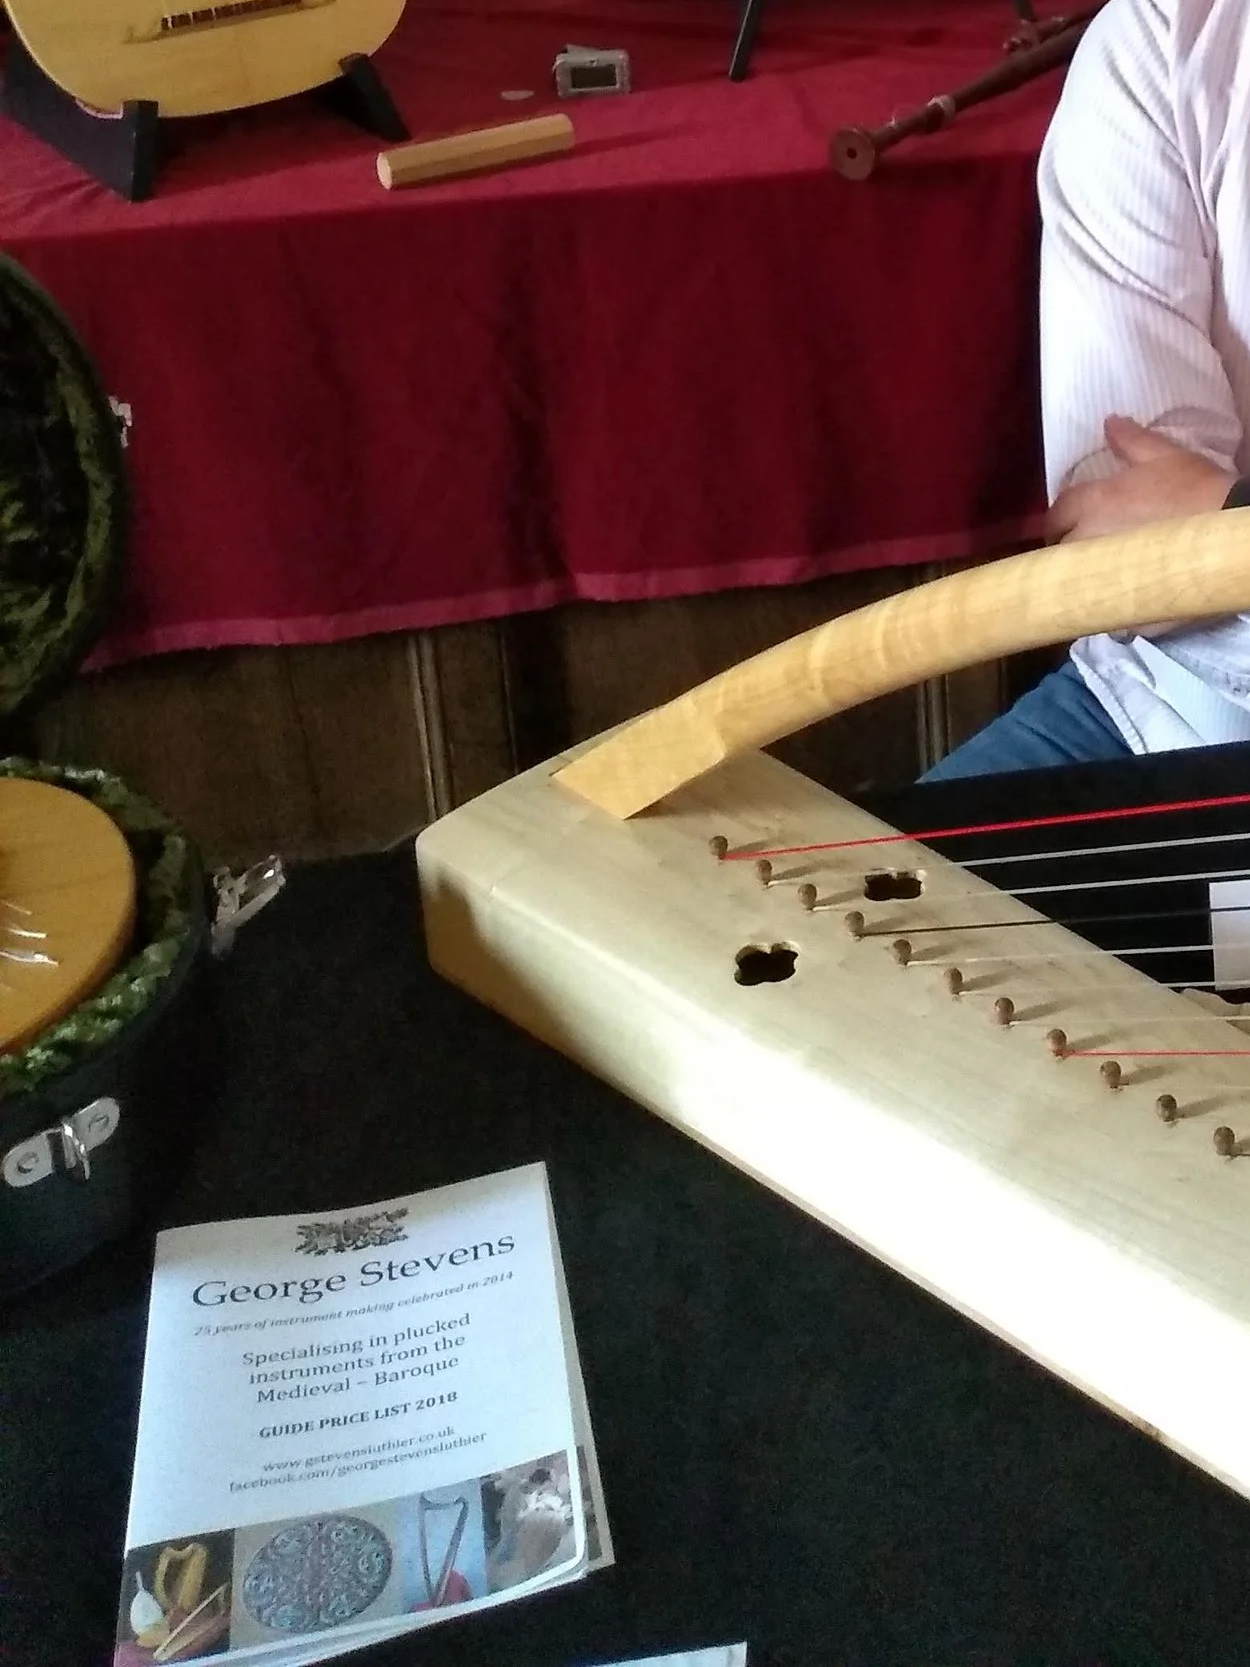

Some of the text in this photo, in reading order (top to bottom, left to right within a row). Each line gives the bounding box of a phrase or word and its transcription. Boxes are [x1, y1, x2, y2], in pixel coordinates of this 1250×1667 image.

[192, 1235, 515, 1307] George Stevens
[213, 1323, 251, 1337] years
[253, 1318, 267, 1330] of
[270, 1310, 343, 1328] instrument
[345, 1301, 394, 1318] making
[397, 1284, 464, 1307] celebrated
[467, 1281, 479, 1290] in
[483, 1270, 514, 1287] 2014
[242, 1313, 471, 1368] Specialising in plucked
[249, 1335, 466, 1385] instruments from the
[257, 1377, 350, 1403] Medieval
[374, 1356, 459, 1386] Baroque
[259, 1390, 458, 1439] GUIDE PRICE LIST 2018
